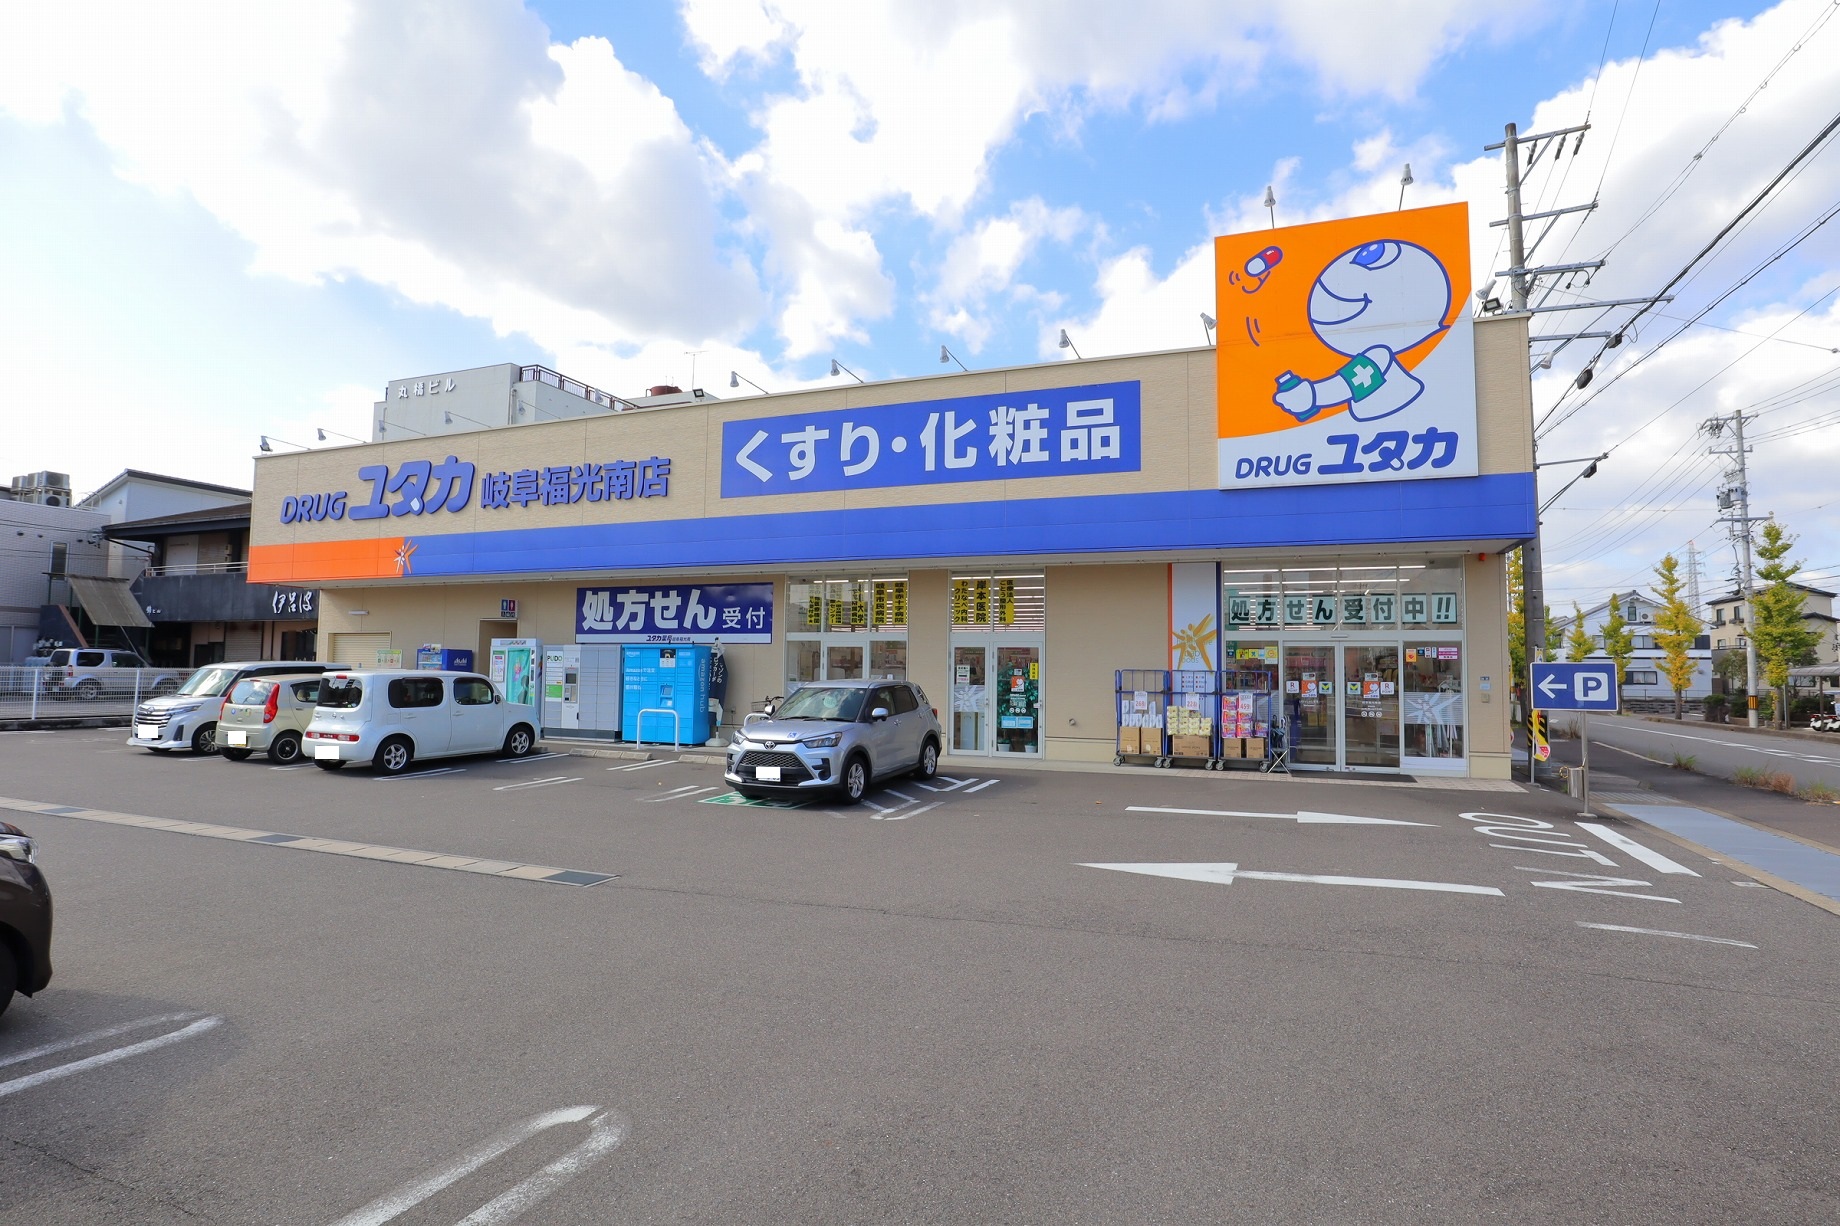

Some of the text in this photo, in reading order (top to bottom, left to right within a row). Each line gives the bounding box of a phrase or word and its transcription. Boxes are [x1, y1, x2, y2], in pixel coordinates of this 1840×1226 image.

[735, 398, 1121, 483] くすり・化粧品
[1235, 427, 1459, 479] DRUG ユタカ
[280, 455, 671, 524] DRUG ユタカ 岐阜福光南店
[582, 589, 766, 631] 処方せん 受付
[875, 582, 885, 623] 岐阜市民病院
[976, 580, 987, 622] 岸本医院
[1582, 676, 1603, 698] P
